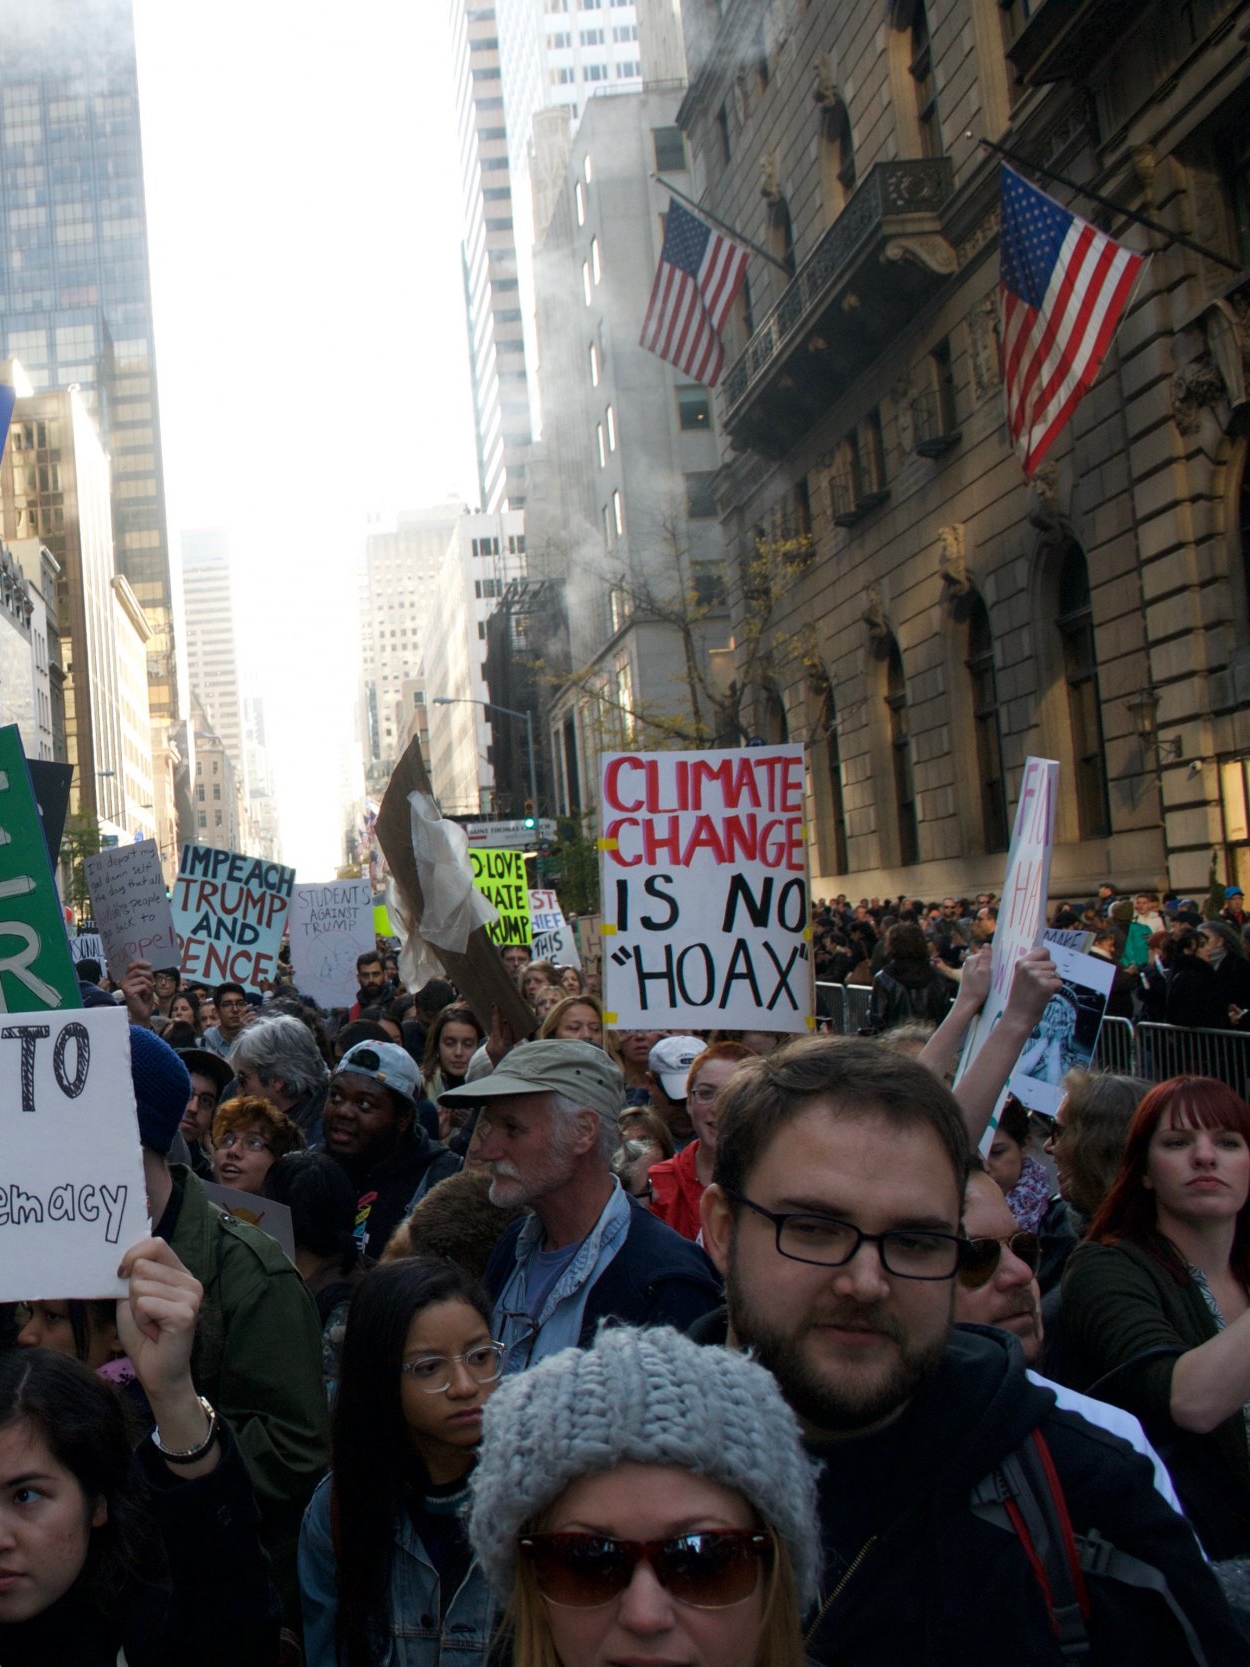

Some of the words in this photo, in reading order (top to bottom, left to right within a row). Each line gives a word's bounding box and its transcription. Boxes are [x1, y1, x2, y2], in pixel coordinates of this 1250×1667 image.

[604, 756, 803, 814] CLIMATE
[605, 813, 805, 871] CHANGE
[180, 844, 296, 897] IMPEACH
[178, 878, 287, 929] TRUMP
[298, 885, 371, 909] STUDENTS
[310, 907, 359, 922] AGAINST
[616, 874, 680, 931] IS
[722, 873, 806, 933] NO
[191, 910, 260, 945] AND
[302, 920, 356, 936] TRUMP
[1043, 930, 1082, 947] MAKE
[1, 1021, 91, 1112] TO
